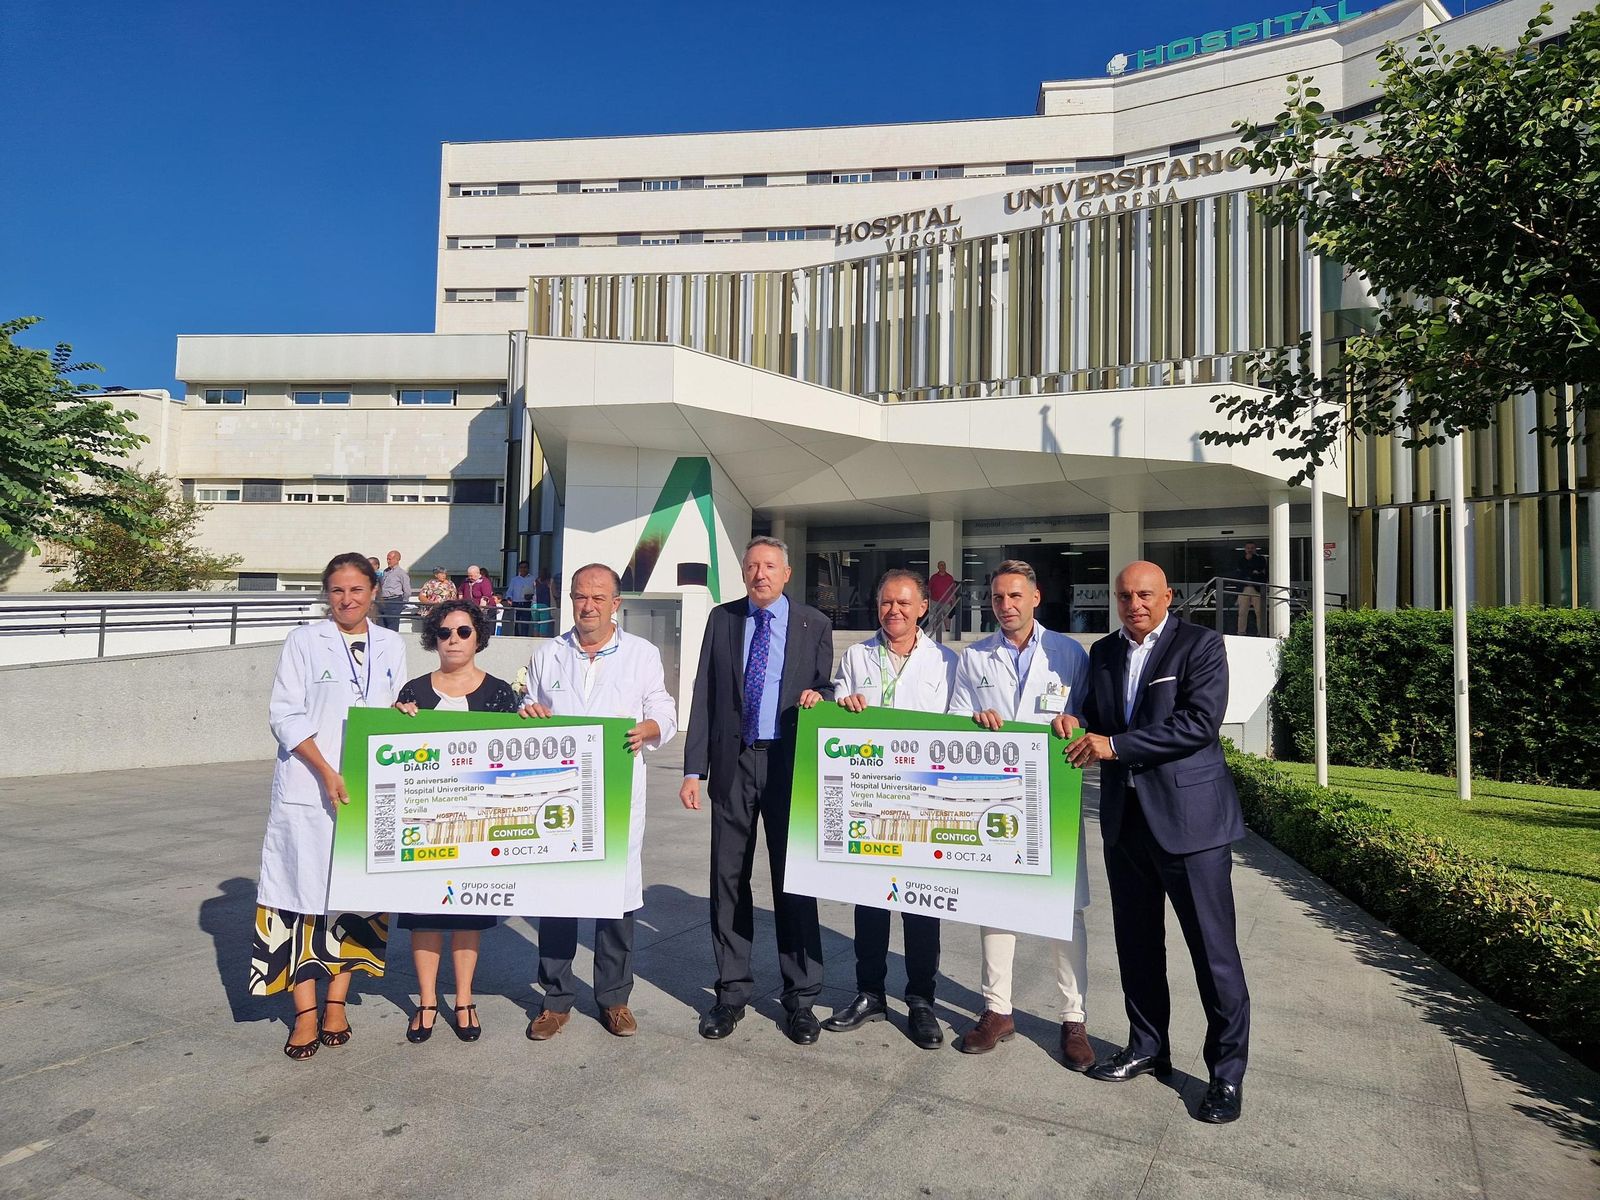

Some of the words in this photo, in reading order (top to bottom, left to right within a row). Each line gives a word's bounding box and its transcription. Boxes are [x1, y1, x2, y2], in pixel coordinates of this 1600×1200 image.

[1137, 0, 1362, 70] HOSPITAL
[835, 204, 961, 247] HOSPITAL
[1003, 146, 1250, 215] UNIVERSITARIO
[885, 226, 963, 252] VIRGEN
[1041, 186, 1179, 226] MACARENA
[448, 741, 477, 755] 000
[488, 735, 576, 762] 00000
[890, 739, 920, 754] 000
[1031, 742, 1041, 751] 2€
[929, 740, 1020, 766] 00000
[451, 758, 473, 766] SERIE
[894, 756, 915, 765] SERIE
[416, 776, 458, 785] aniversario
[850, 772, 860, 780] 50
[862, 772, 901, 781] aniversario
[404, 786, 435, 797] Hospital
[437, 784, 485, 793] Universitario
[850, 781, 879, 791] Hospital
[881, 783, 927, 792] Universitario
[405, 797, 429, 805] Virgen
[432, 795, 468, 804] Macarena
[851, 791, 874, 799] Virgen
[876, 792, 911, 800] Macarena
[850, 800, 873, 808] Sevilla
[404, 806, 428, 814] Sevilla
[493, 828, 534, 838] CONTIGO
[935, 832, 977, 842] CONTIGO
[417, 848, 455, 859] ONCE
[503, 848, 509, 856] 8
[512, 846, 535, 856] OCT.
[537, 845, 548, 854] 24
[863, 843, 899, 855] ONCE
[946, 851, 952, 860] 8
[954, 852, 978, 862] OCT.
[980, 853, 992, 862] 24
[461, 882, 488, 890] grupo
[490, 882, 516, 890] social
[905, 881, 932, 891] grupo
[934, 885, 959, 895] social
[460, 892, 515, 907] ONCE
[904, 891, 958, 912] ONCE
